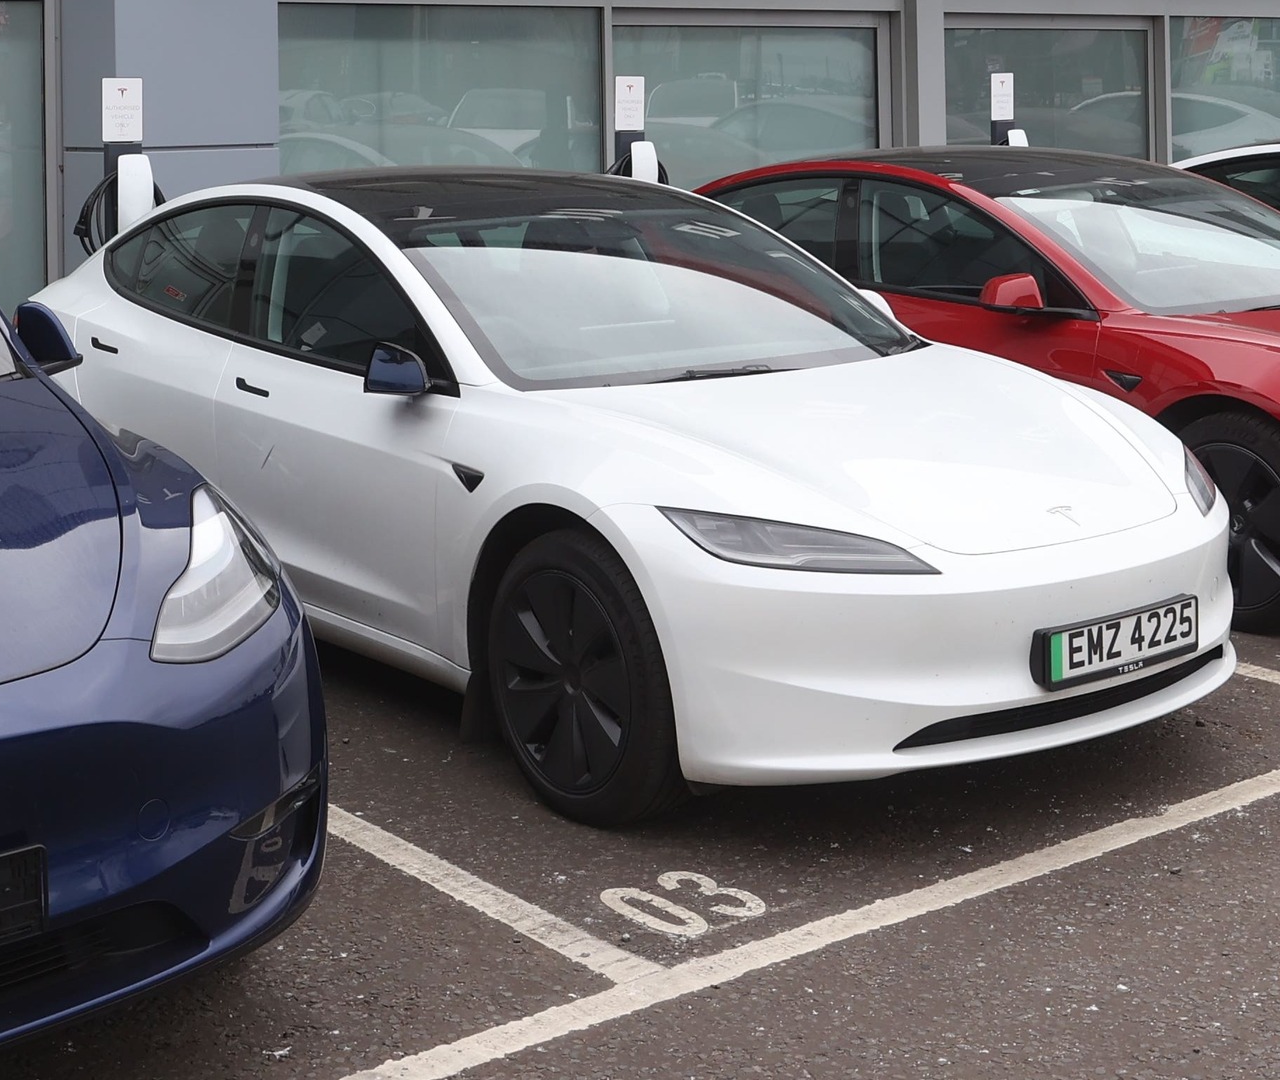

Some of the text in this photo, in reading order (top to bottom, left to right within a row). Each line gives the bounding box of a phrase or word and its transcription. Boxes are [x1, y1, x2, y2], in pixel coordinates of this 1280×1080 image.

[1068, 601, 1193, 670] EMZ 4225
[1118, 661, 1144, 674] TESLA
[599, 871, 766, 939] 03
